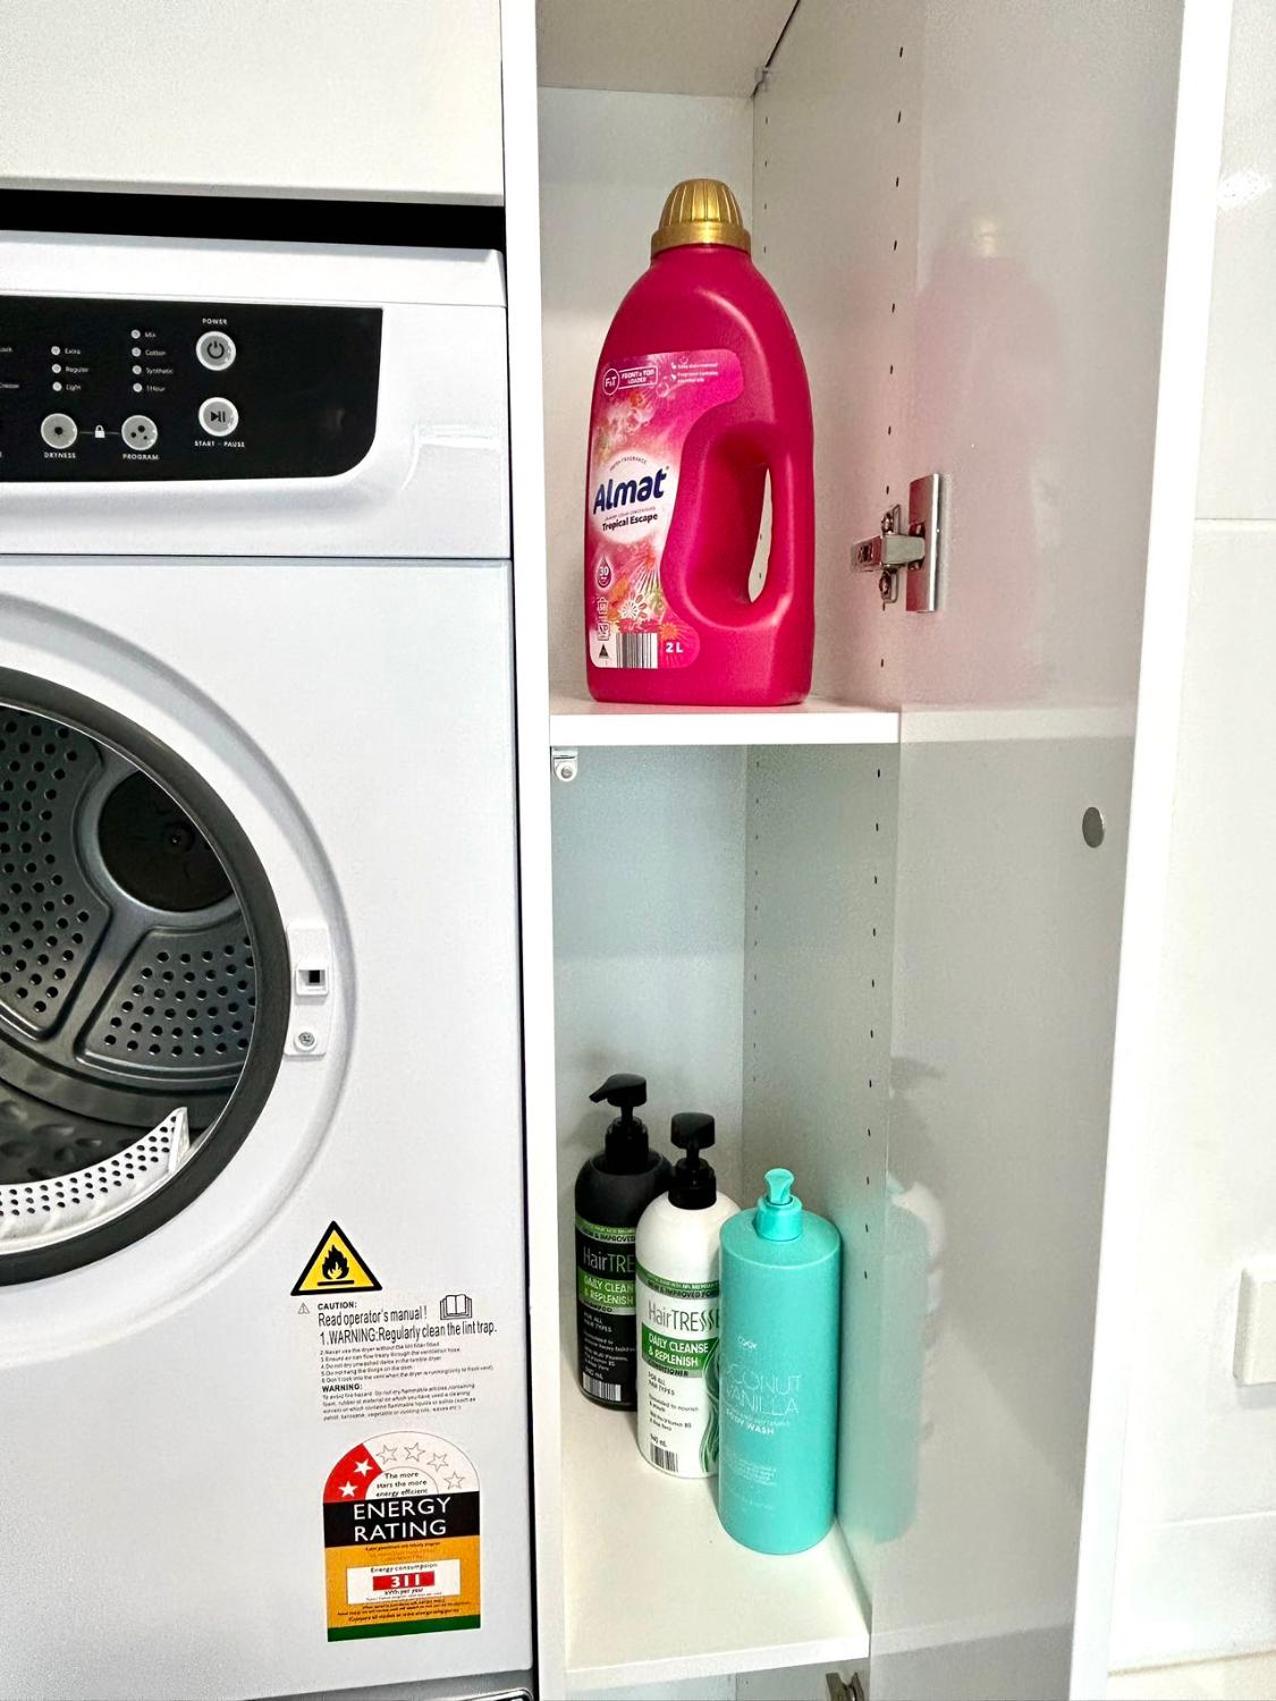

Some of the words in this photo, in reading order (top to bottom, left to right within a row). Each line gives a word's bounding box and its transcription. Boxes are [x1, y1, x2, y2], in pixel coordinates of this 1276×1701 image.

[194, 440, 216, 448] START
[223, 441, 246, 449] PAUSE
[43, 452, 77, 460] DRYNESS
[122, 454, 159, 463] PROGRAM
[592, 468, 667, 515] Almat
[602, 517, 629, 531] Tropical
[630, 513, 658, 524] Escape
[317, 1301, 357, 1310] CAUTION:
[318, 1311, 343, 1327] Read
[421, 1324, 446, 1338] clean
[447, 1322, 460, 1336] the
[461, 1320, 476, 1335] lint
[476, 1319, 498, 1336] trap.
[648, 1332, 669, 1350] DAILY
[669, 1340, 709, 1354] CLEANSE
[655, 1348, 699, 1368] REPLENISH
[322, 1383, 363, 1392] WARNING:
[385, 1471, 399, 1480] The
[399, 1471, 420, 1479] more
[395, 1480, 407, 1488] the
[408, 1479, 428, 1487] more
[375, 1490, 400, 1498] energy
[400, 1488, 429, 1496] efficient
[353, 1496, 452, 1521] ENERGY
[353, 1519, 447, 1542] RATING
[370, 1565, 394, 1573] Energy
[394, 1563, 438, 1571] consumption
[391, 1573, 421, 1589] 311
